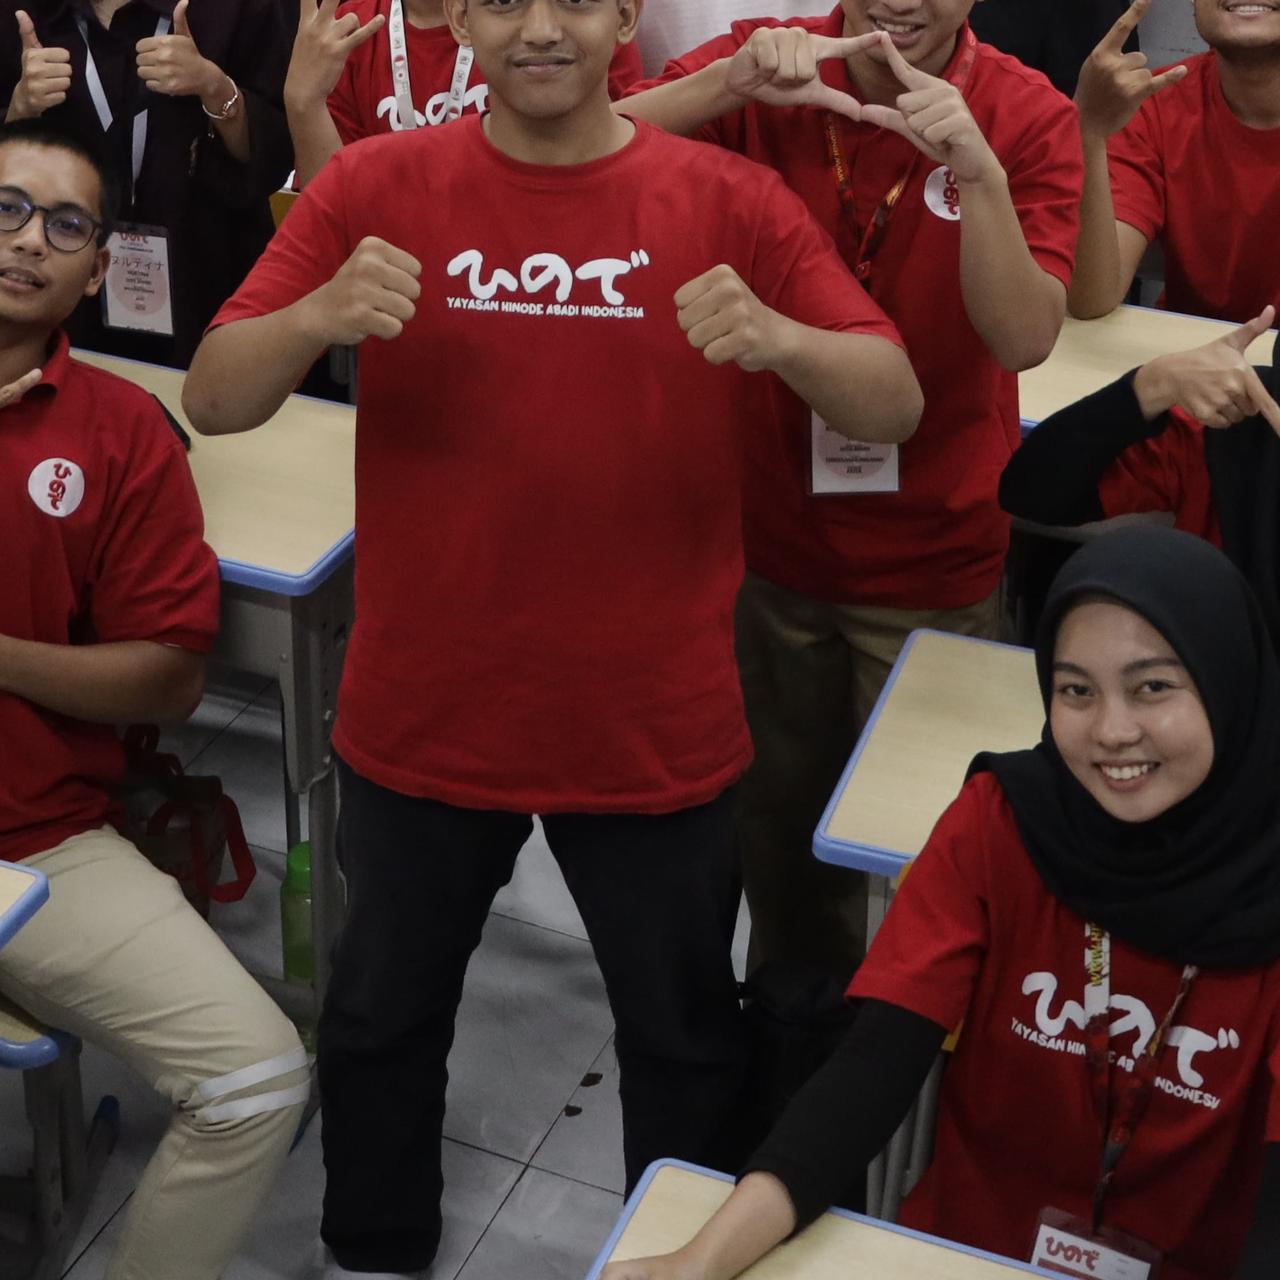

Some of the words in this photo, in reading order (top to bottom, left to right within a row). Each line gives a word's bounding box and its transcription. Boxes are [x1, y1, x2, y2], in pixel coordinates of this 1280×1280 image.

[446, 248, 650, 306] ひので
[446, 296, 500, 312] YAYASAN
[501, 302, 544, 315] HINODE
[545, 304, 580, 317] ABADI
[581, 306, 645, 319] INDONESIA
[47, 462, 73, 511] ひので
[1011, 1017, 1066, 1053] YAYASAN
[1021, 971, 1240, 1089] ひので
[1045, 1236, 1100, 1271] ひので
